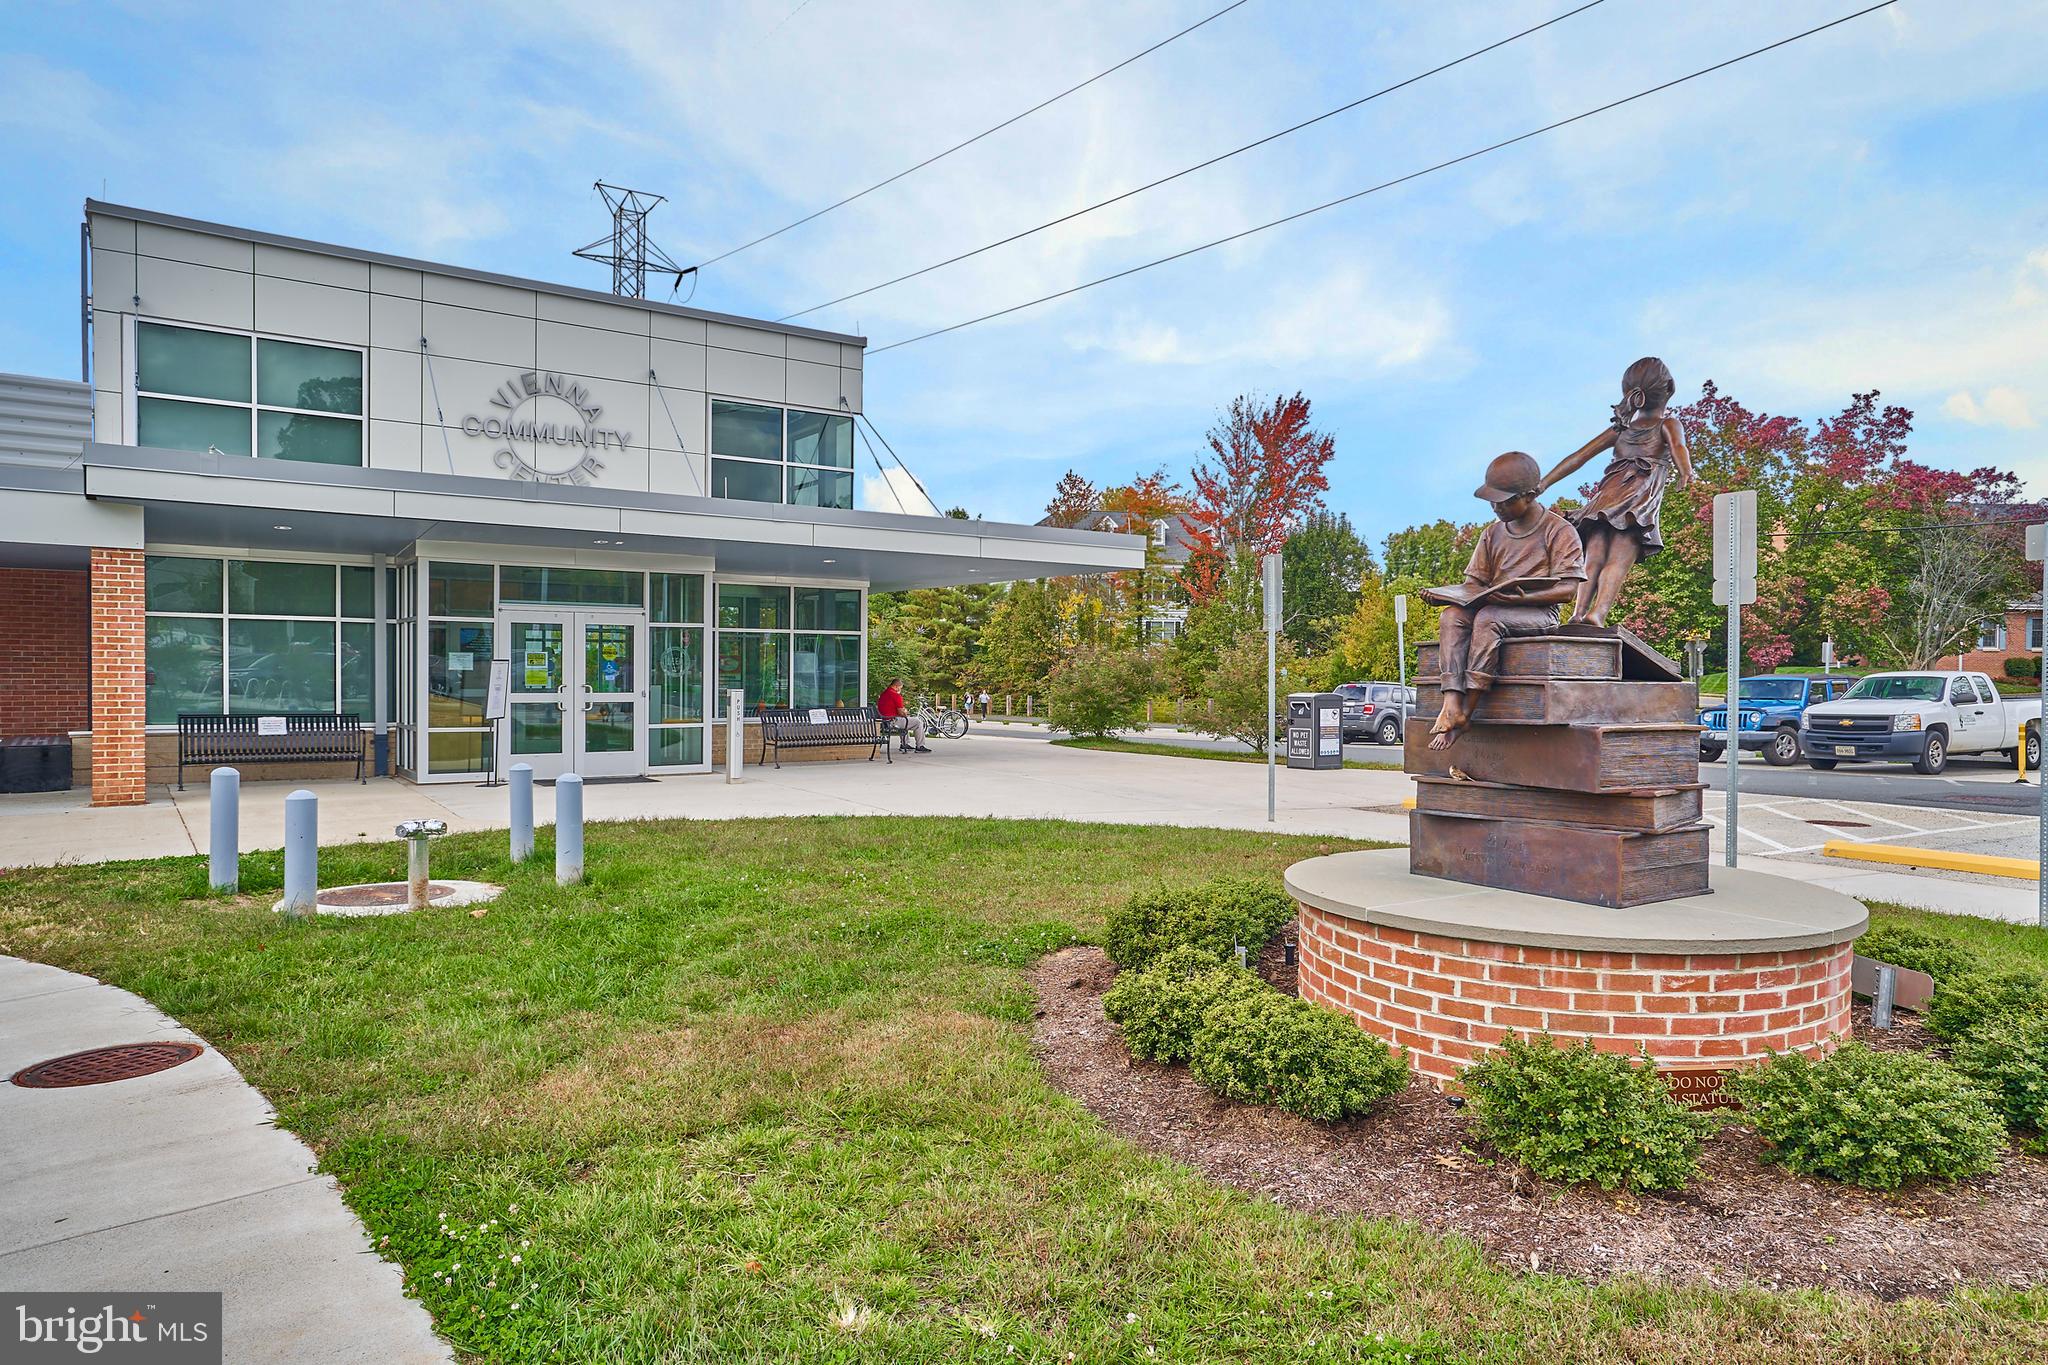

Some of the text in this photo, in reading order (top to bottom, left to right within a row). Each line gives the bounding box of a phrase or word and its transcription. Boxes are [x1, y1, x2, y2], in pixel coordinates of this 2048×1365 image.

[489, 371, 602, 423] VIENNA
[462, 415, 632, 451] COMMUNITY
[1291, 747, 1310, 755] ALLOWED
[1670, 1076, 1692, 1089] DO
[1694, 1075, 1728, 1088] NOT
